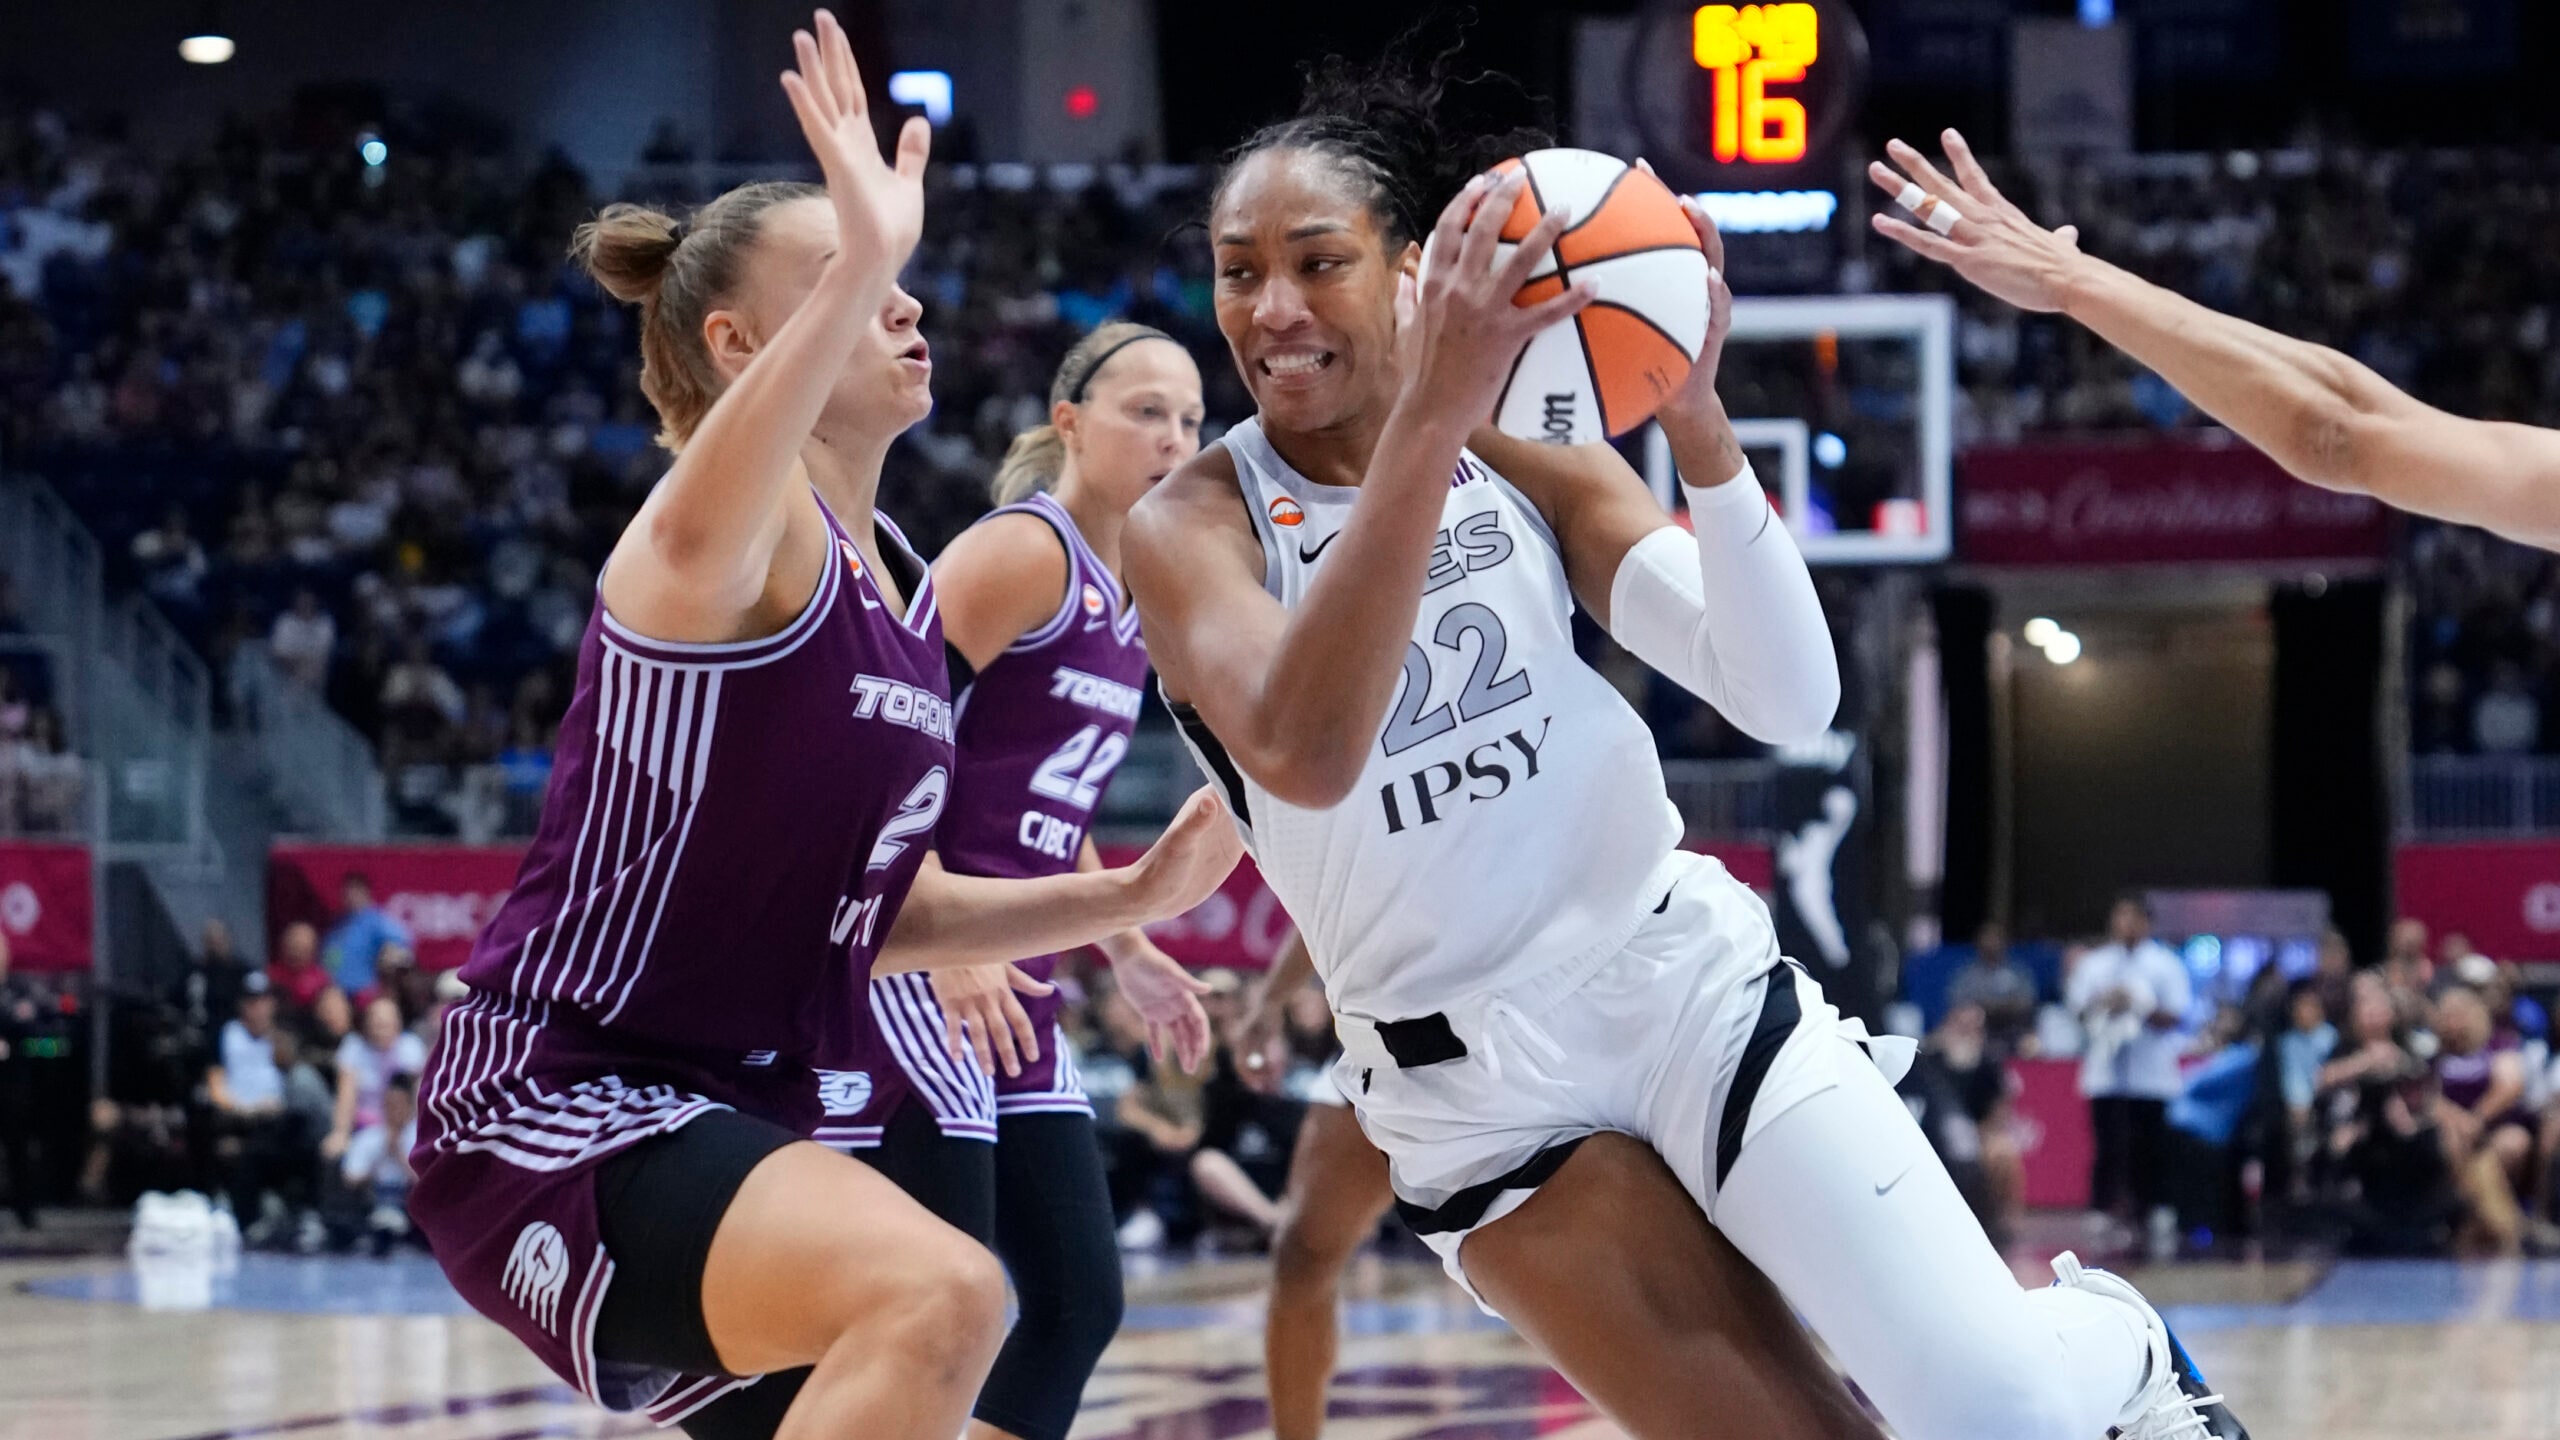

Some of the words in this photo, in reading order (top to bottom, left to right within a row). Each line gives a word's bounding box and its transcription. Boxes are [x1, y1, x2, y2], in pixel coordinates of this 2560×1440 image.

[1712, 59, 1806, 164] 16
[1421, 510, 1514, 597] ES
[1381, 602, 1532, 758] 22
[865, 765, 949, 873] 2
[1028, 724, 1129, 811] 22
[1380, 715, 1552, 835] IPSY
